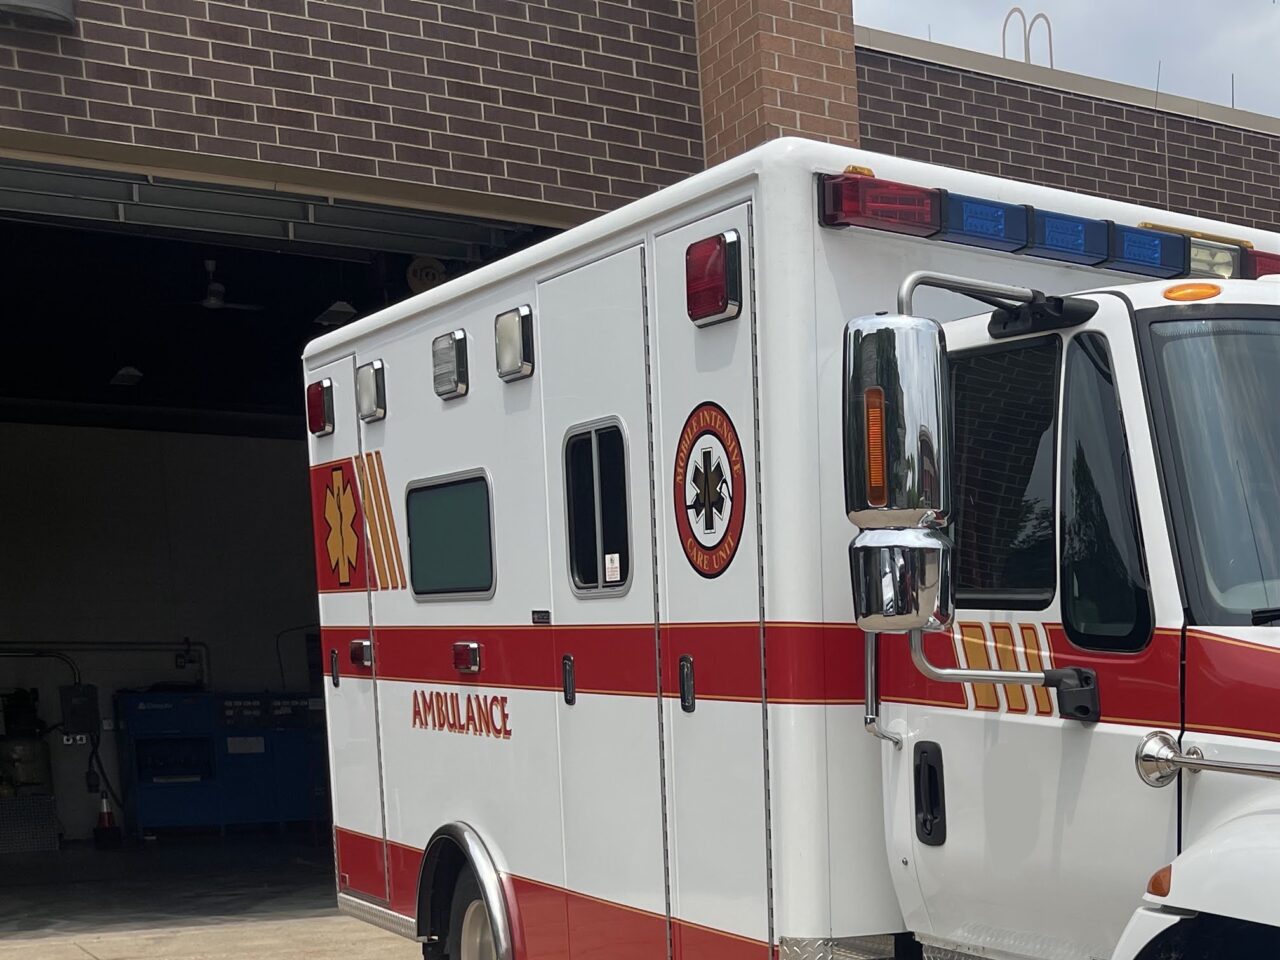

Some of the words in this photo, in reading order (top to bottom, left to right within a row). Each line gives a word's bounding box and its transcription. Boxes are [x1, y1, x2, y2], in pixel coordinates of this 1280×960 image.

[676, 416, 698, 485] MOBILE
[700, 410, 742, 478] INTENSIVE
[687, 537, 710, 570] CARE
[712, 533, 735, 569] UNIT
[412, 689, 512, 740] AMBULANCE
